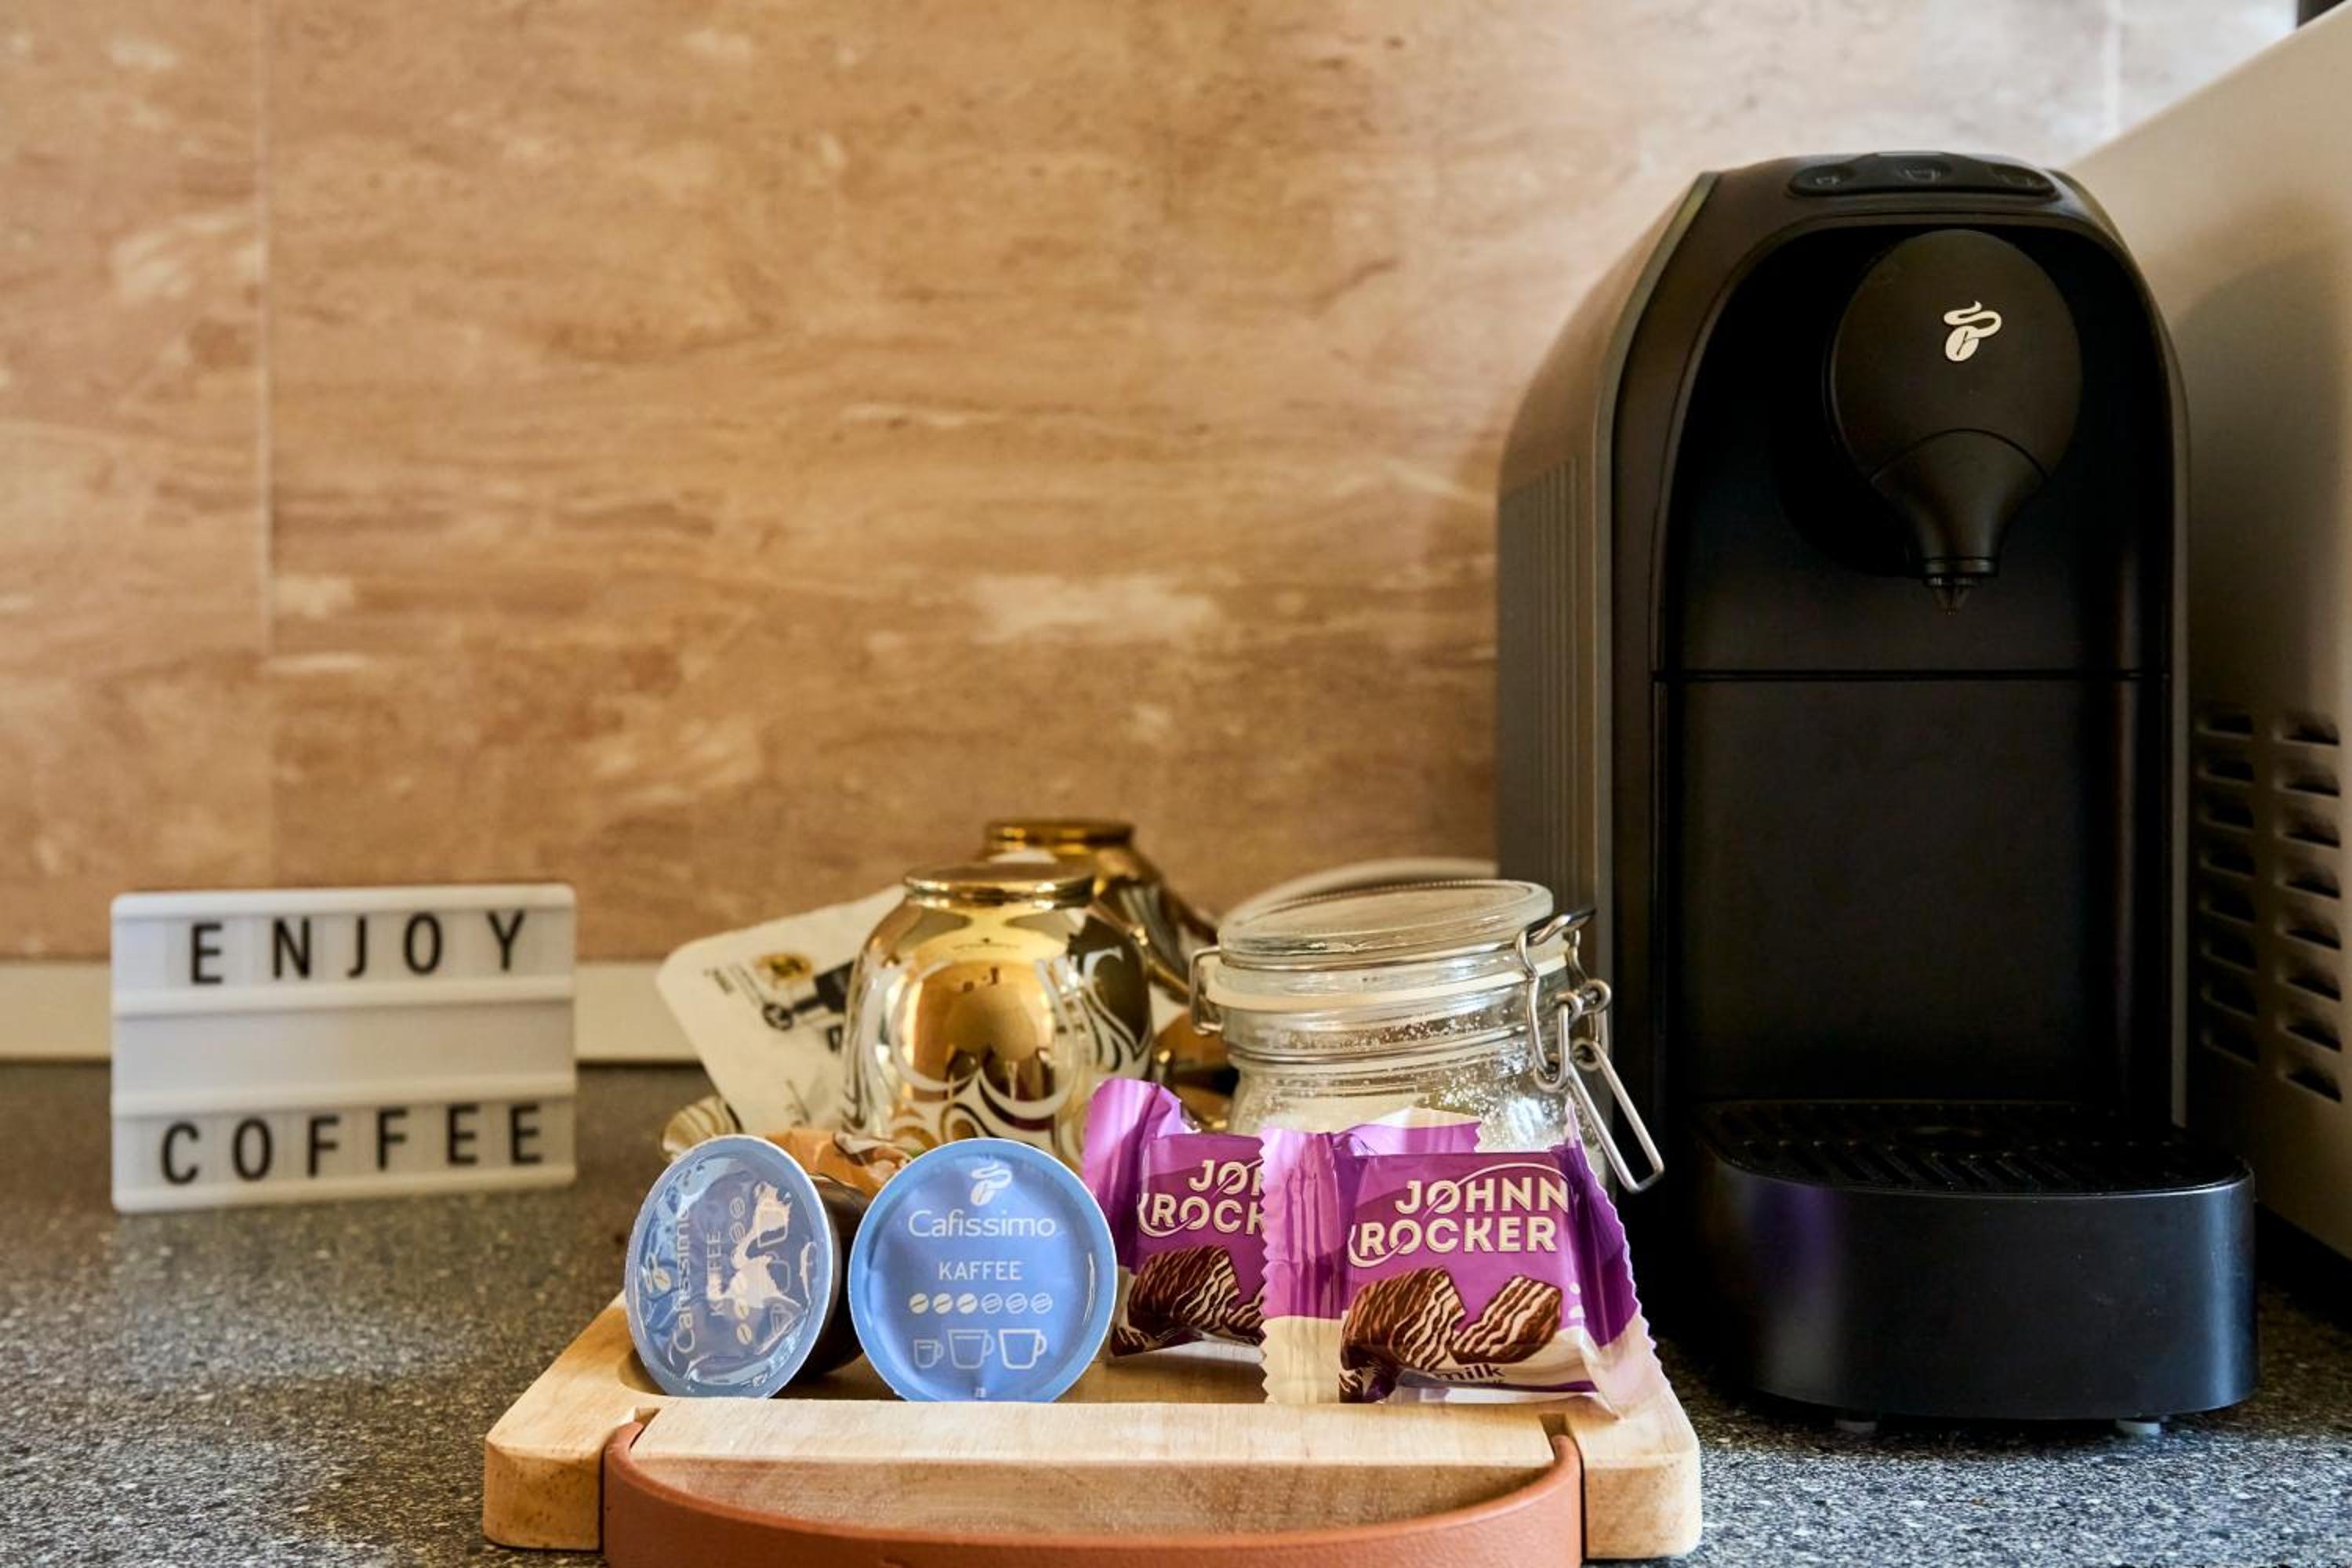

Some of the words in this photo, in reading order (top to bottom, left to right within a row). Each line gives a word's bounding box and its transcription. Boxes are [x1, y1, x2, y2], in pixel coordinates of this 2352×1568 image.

[190, 910, 526, 985] ENJOY
[160, 1102, 543, 1185] COFFEE
[908, 1208, 1056, 1237] Cafissimo
[938, 1261, 1024, 1281] KAFFEE
